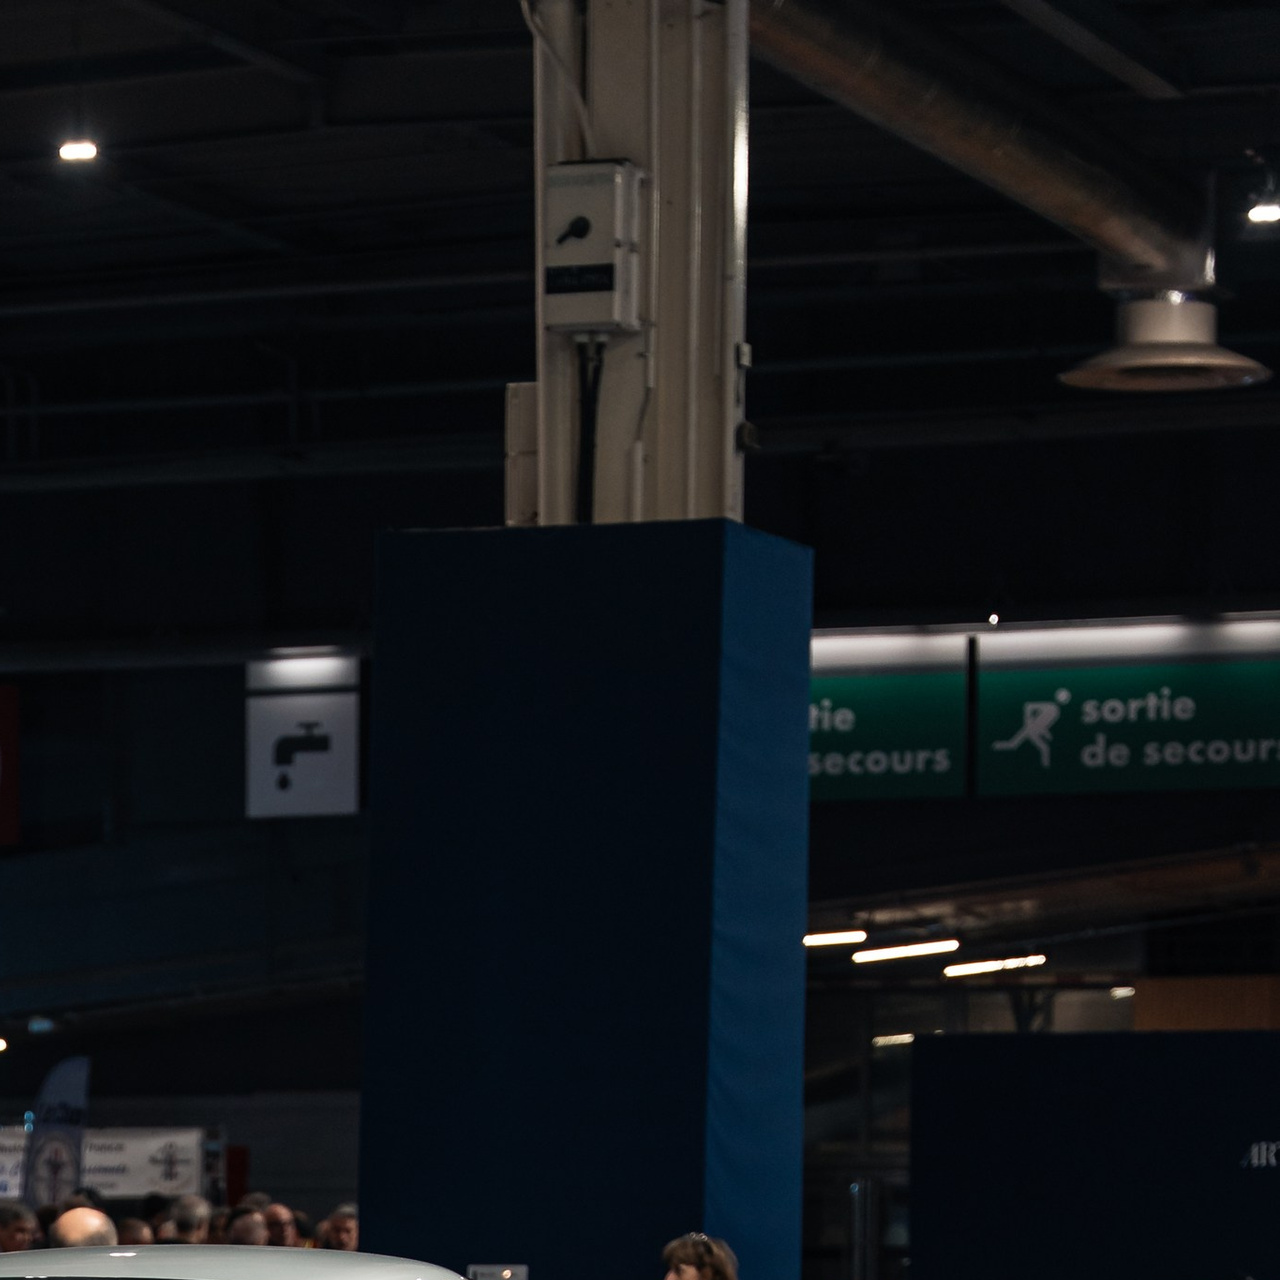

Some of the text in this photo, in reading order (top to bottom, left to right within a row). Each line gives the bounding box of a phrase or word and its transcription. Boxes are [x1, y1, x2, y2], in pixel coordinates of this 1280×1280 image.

[1081, 686, 1196, 724] sortie
[1081, 732, 1280, 768] de secour
